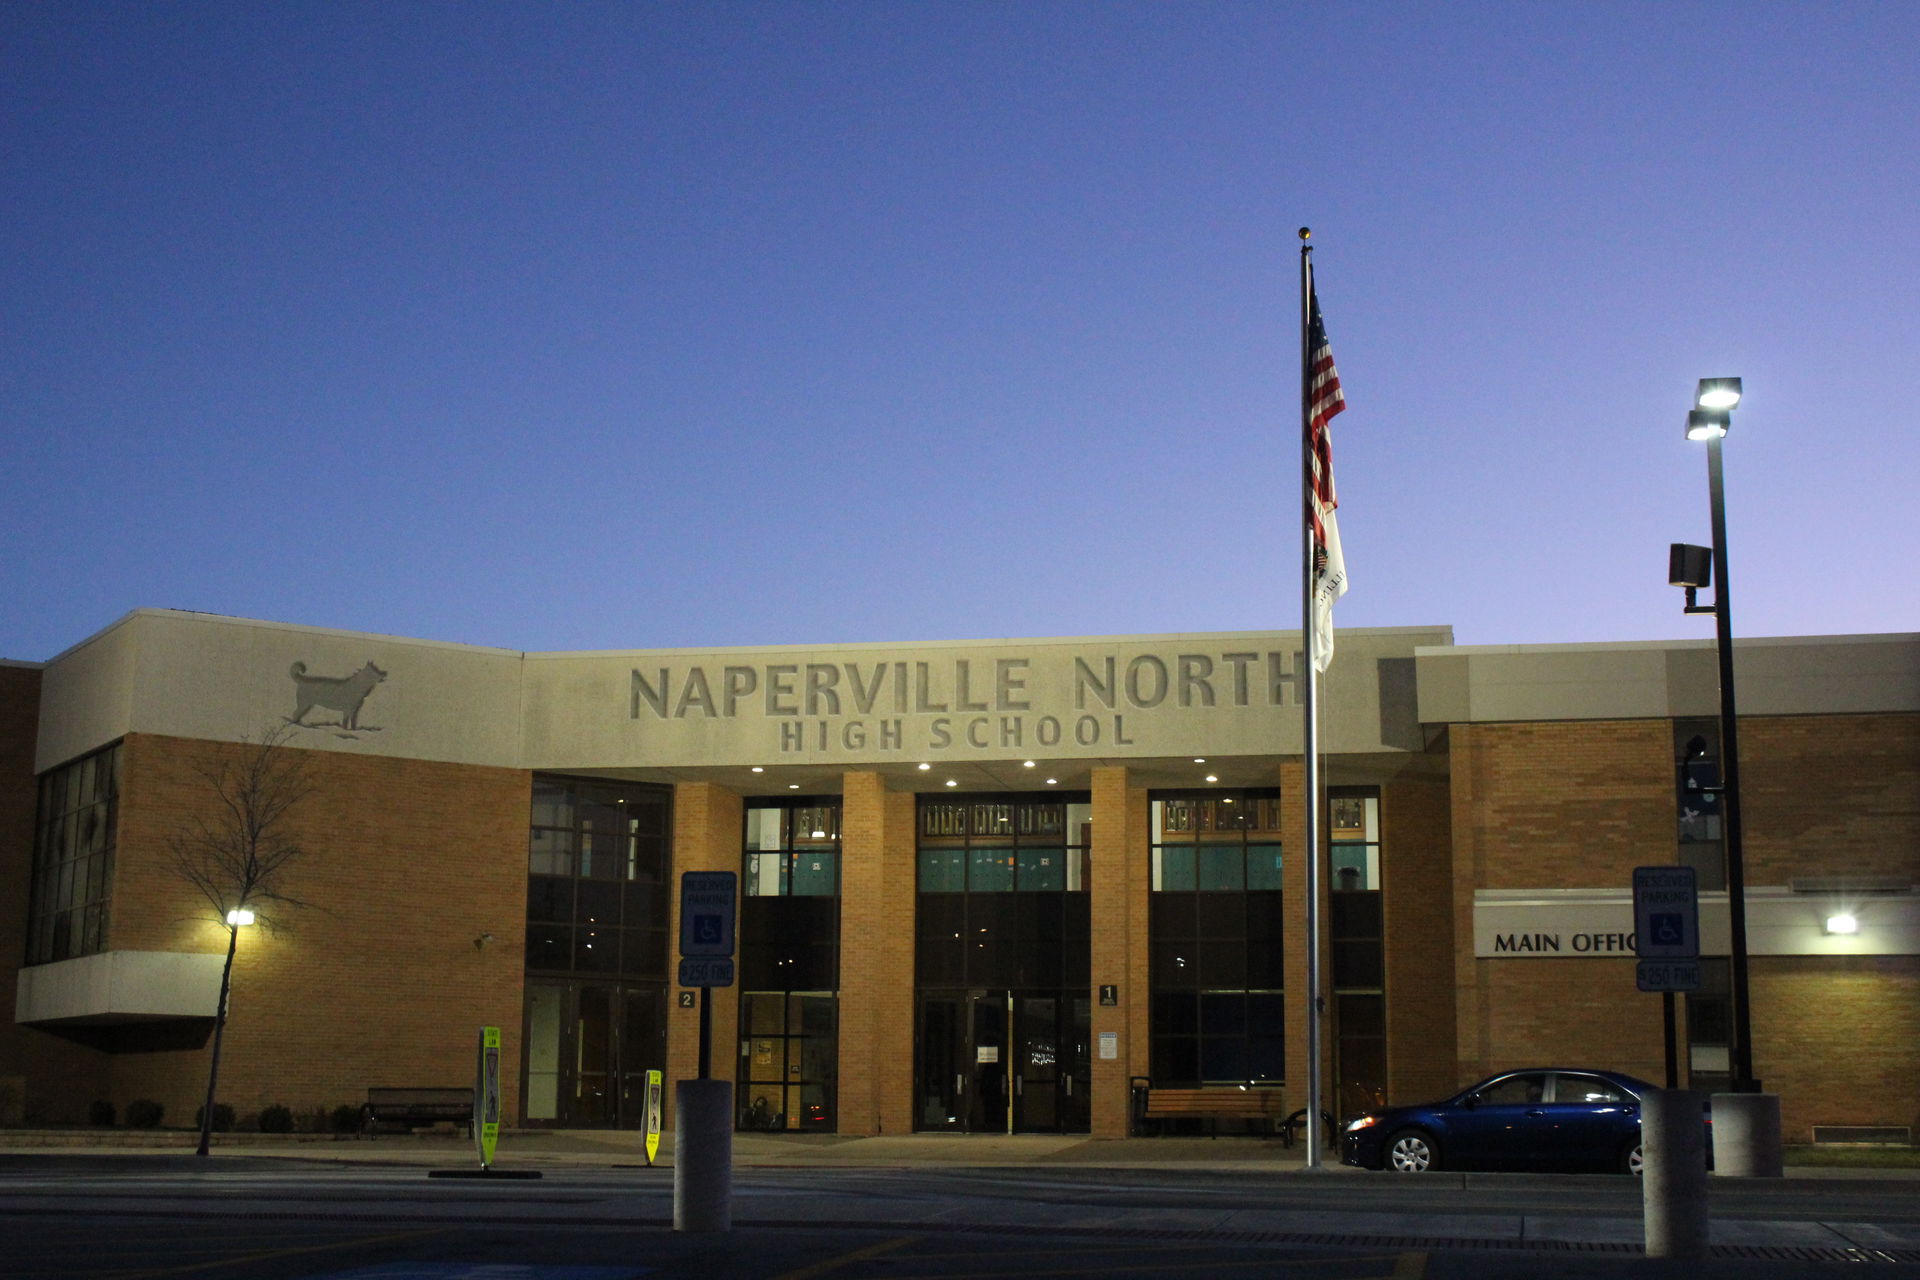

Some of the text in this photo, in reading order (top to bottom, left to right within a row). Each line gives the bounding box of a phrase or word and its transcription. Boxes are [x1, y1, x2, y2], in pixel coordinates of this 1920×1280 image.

[629, 651, 1304, 720] NAPERVILLE NORTH
[780, 714, 1134, 751] HIGH SCHOOL
[685, 879, 733, 890] RESERVED
[1637, 876, 1692, 888] RESERVED
[688, 894, 729, 905] PARKING
[1641, 891, 1689, 904] PARKING
[1495, 933, 1638, 952] MAIN OFFIC
[712, 964, 732, 981] FINE
[1674, 967, 1699, 985] FINE
[1105, 986, 1112, 998] 1
[683, 993, 691, 1006] 2
